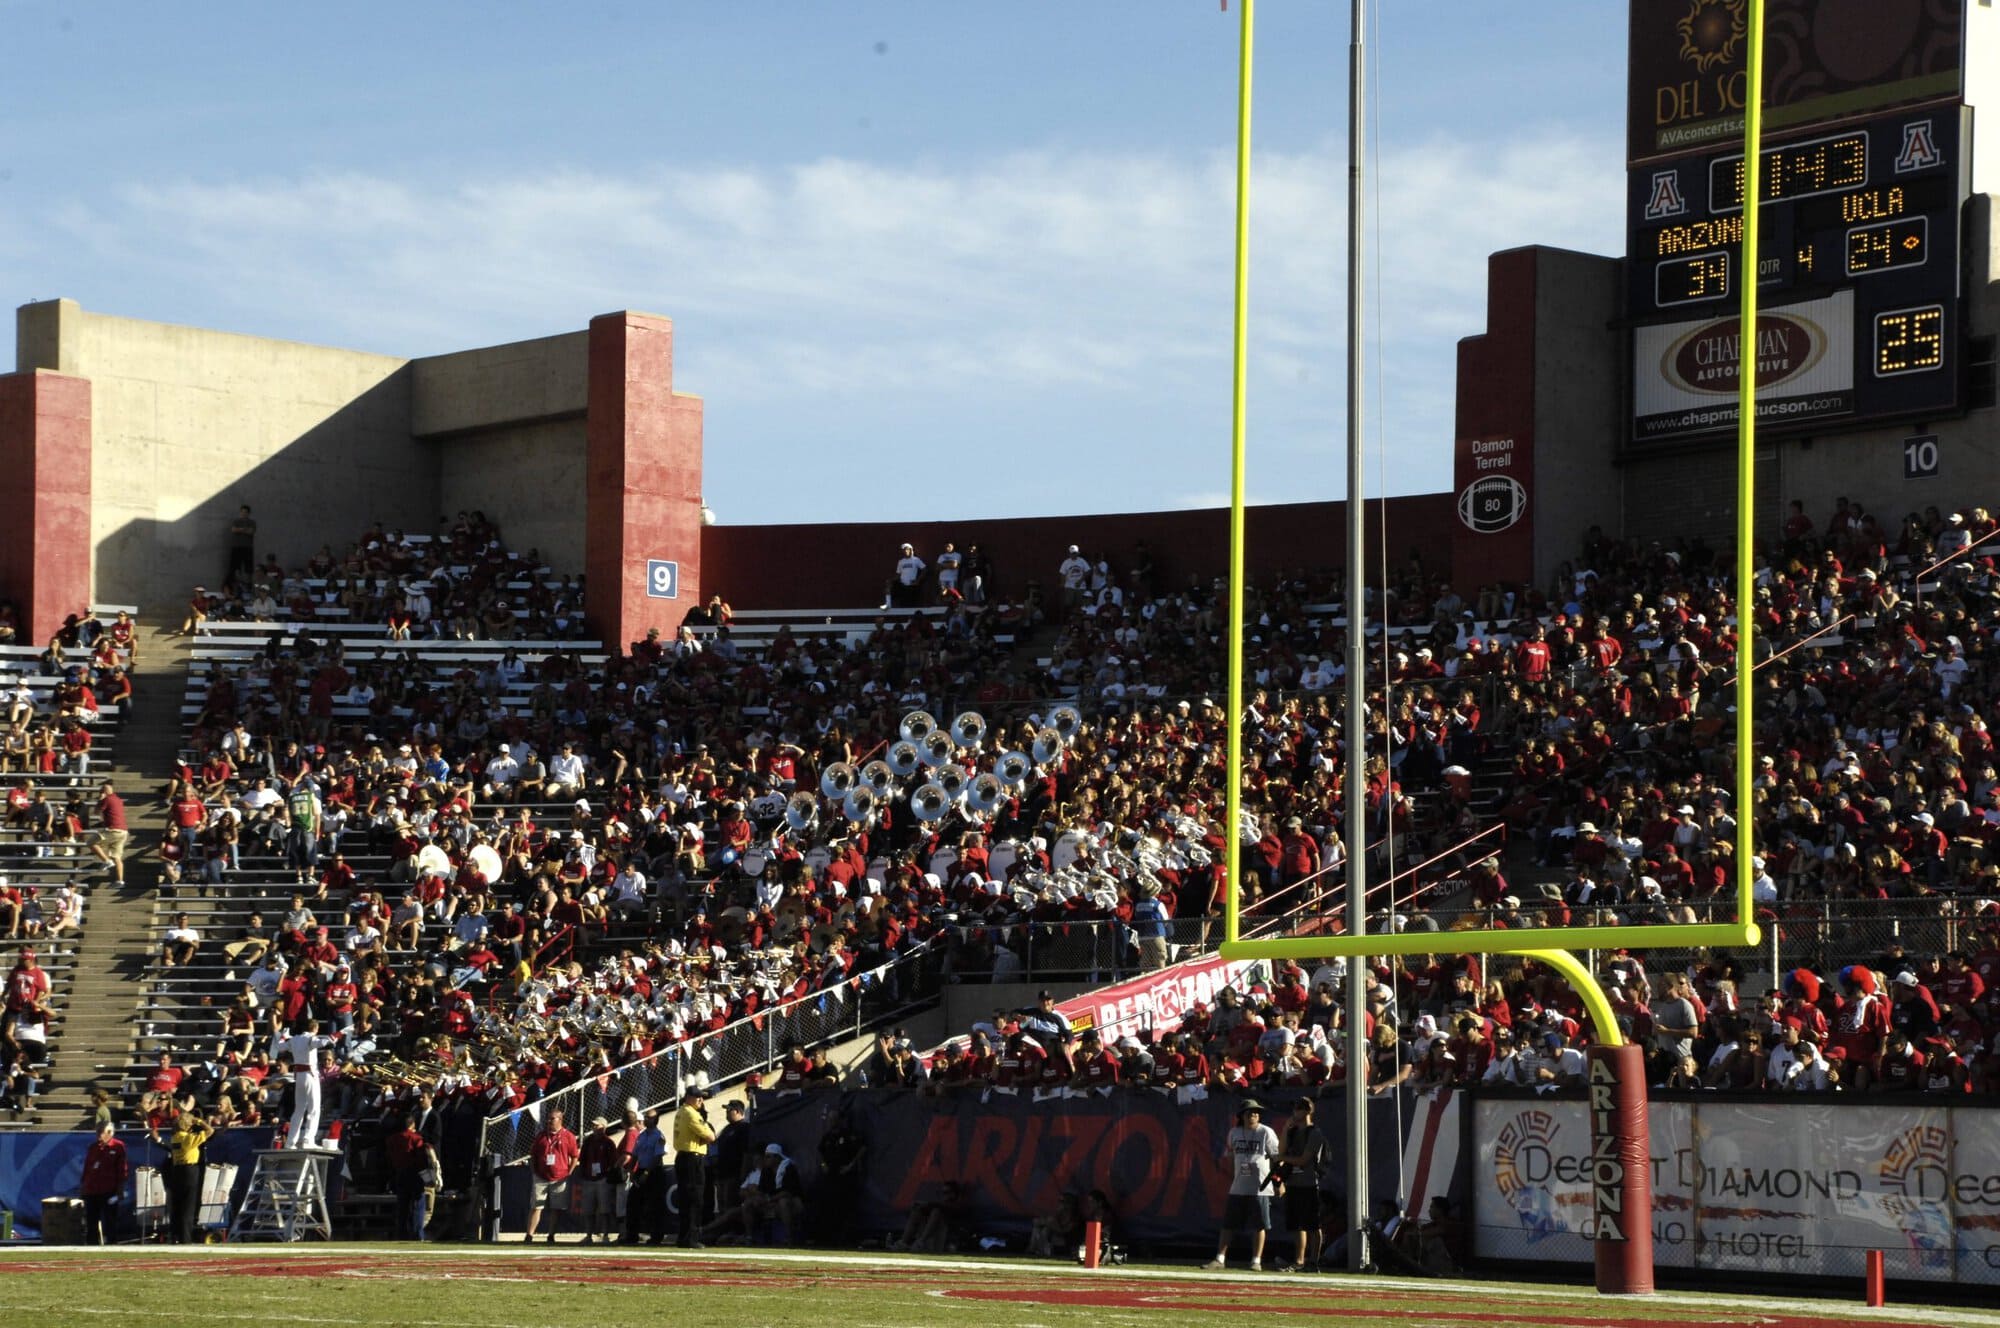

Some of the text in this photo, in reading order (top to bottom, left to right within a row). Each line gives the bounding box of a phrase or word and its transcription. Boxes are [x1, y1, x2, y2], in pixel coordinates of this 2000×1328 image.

[1656, 80, 1705, 126] DEL
[1660, 115, 1764, 146] AVAconcerts.c
[1842, 187, 1903, 222] UCLA
[1798, 244, 1813, 272] 4
[1850, 228, 1891, 270] 24
[1688, 257, 1726, 296] 34
[1881, 311, 1940, 371] 25
[1697, 358, 1790, 382] AUTOTIVE
[1646, 396, 1842, 431] www.chapmatucson.com
[1472, 439, 1514, 454] Damon
[1475, 453, 1511, 470] Terrell
[1904, 441, 1938, 473] 10
[1484, 498, 1501, 512] 80
[654, 566, 671, 592] 9
[760, 803, 776, 815] 32
[1099, 990, 1152, 1045] RED
[893, 1112, 1296, 1218] ARIZON
[1590, 1058, 1625, 1240] ARIZONA
[1522, 1145, 1862, 1201] DEST DIAMOND
[1581, 1219, 1811, 1259] CNO HOTEL
